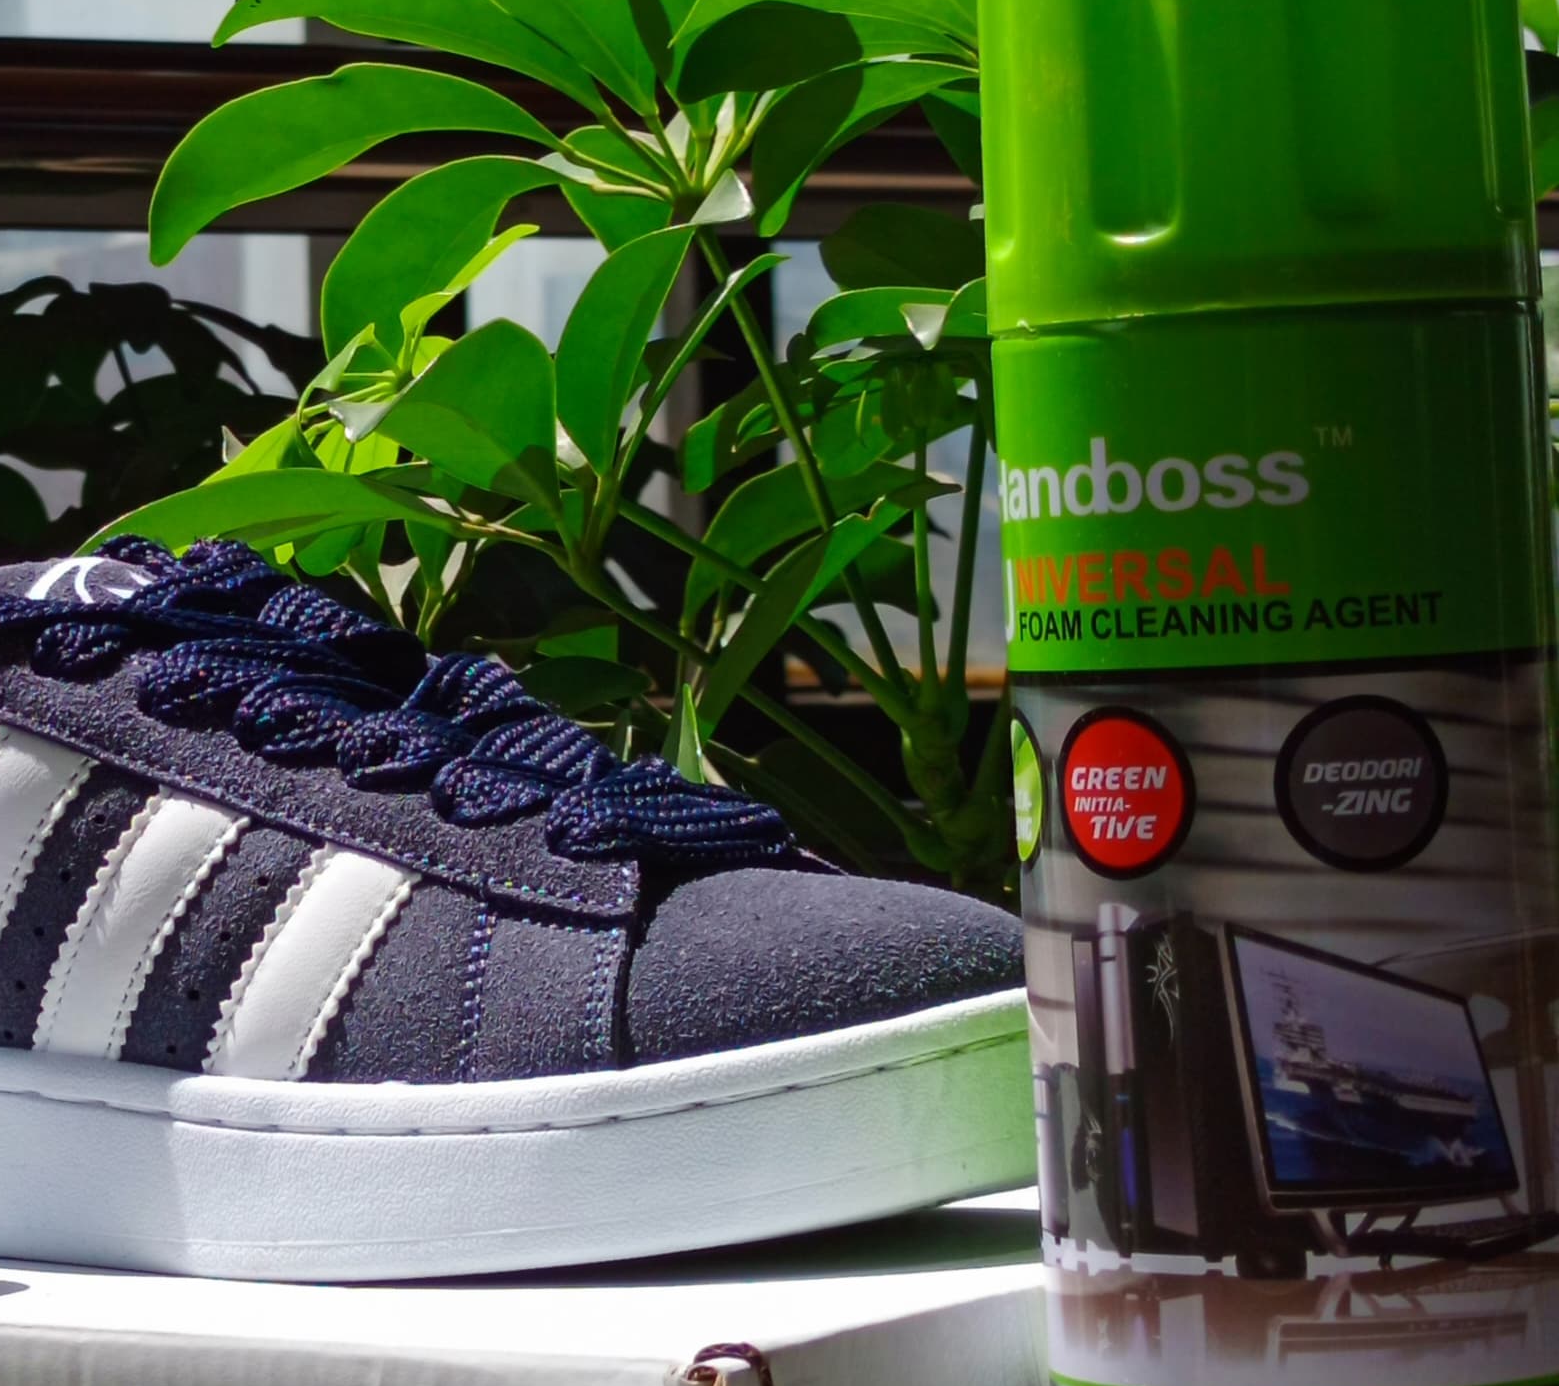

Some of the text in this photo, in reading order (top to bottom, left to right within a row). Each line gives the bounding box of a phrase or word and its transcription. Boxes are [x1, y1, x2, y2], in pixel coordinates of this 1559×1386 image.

[1313, 424, 1354, 448] TM
[1019, 590, 1443, 642] FOAM CLEANING AGENT
[1070, 765, 1168, 791] GREEN
[1303, 757, 1424, 784] DEODORI
[1073, 796, 1131, 813] INITIA-
[1321, 788, 1414, 816] -ZING
[1089, 815, 1157, 840] TIVE
